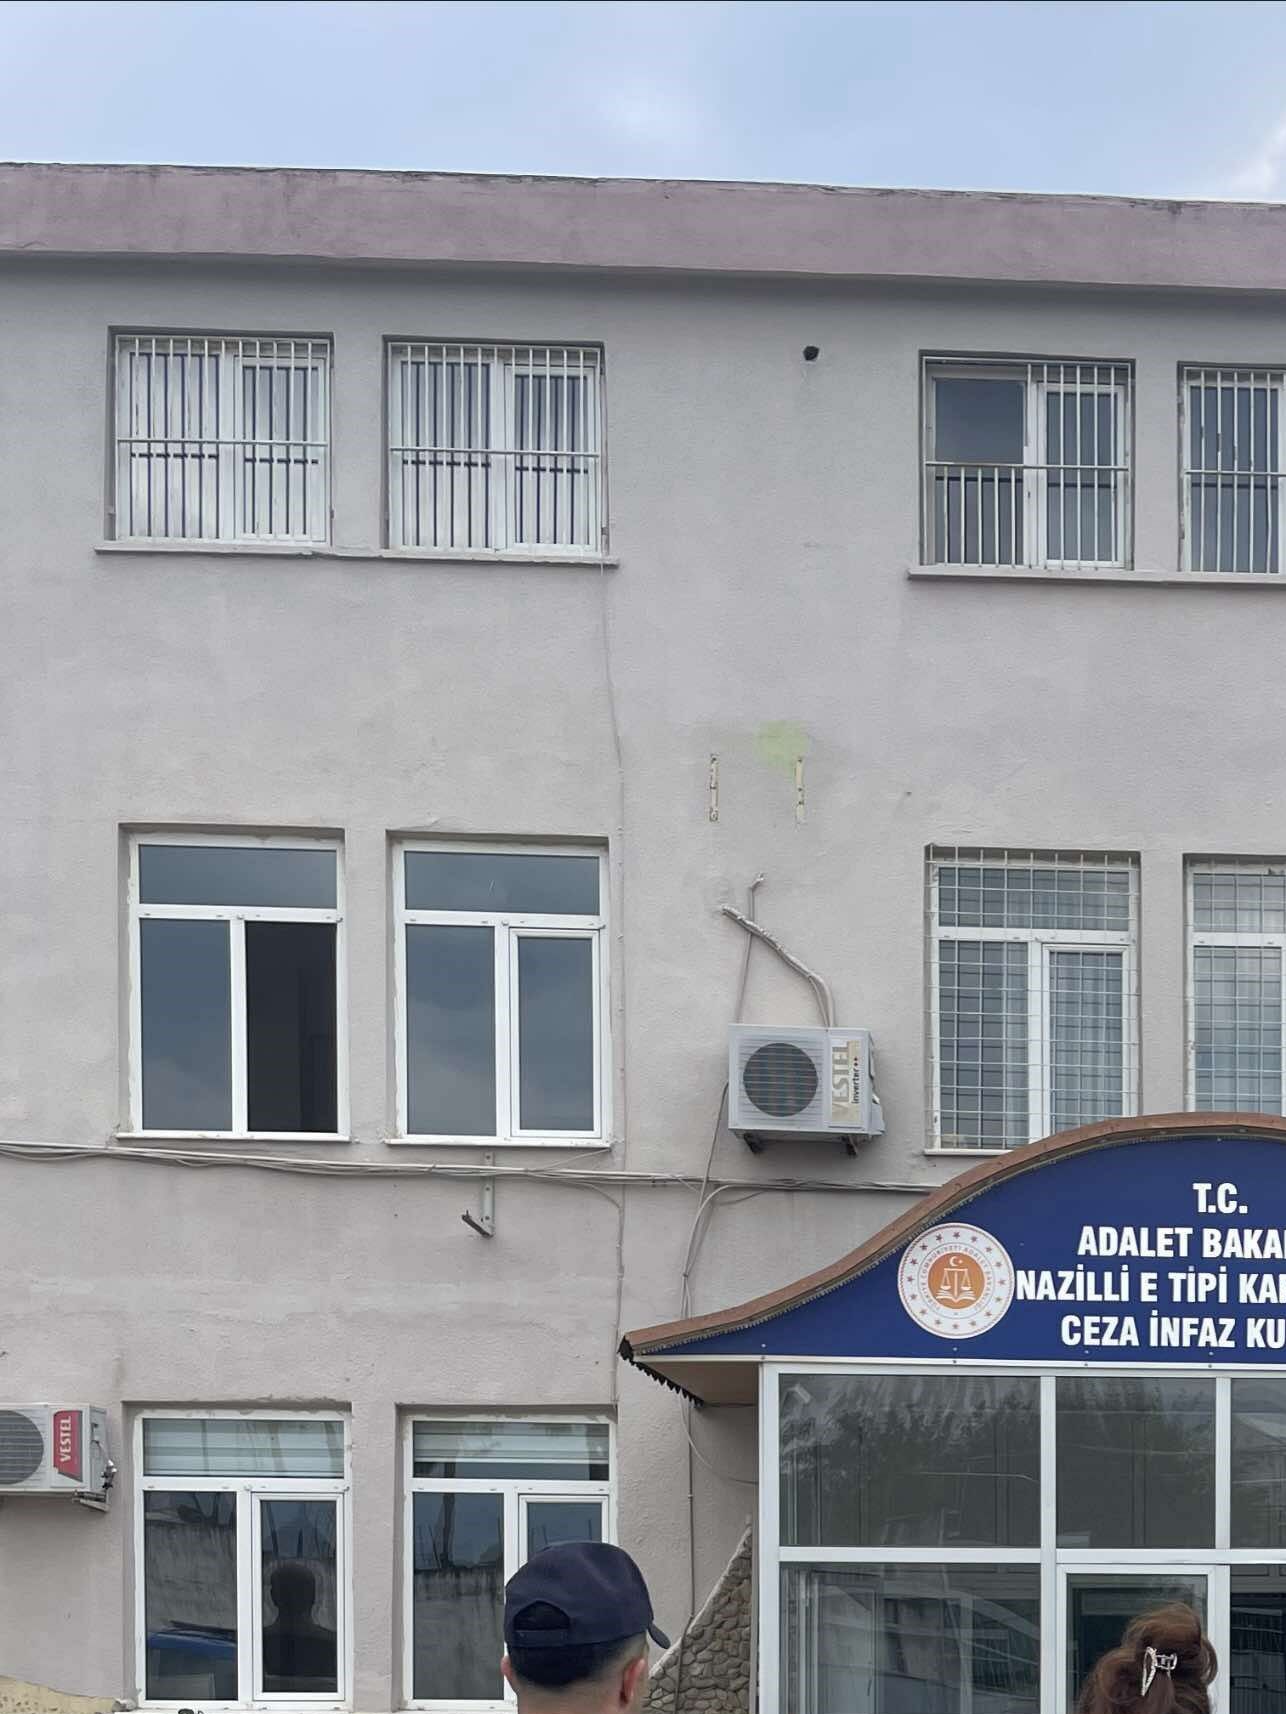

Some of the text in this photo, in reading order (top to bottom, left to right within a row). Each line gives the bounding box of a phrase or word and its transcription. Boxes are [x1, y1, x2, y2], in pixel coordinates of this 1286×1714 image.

[851, 1068, 860, 1104] inverter
[1193, 1183, 1248, 1213] T.C.
[1077, 1226, 1193, 1257] ADALET
[1016, 1264, 1130, 1302] NAZİLLİ
[1141, 1272, 1158, 1302] E
[1168, 1266, 1227, 1303] TİPİ
[1061, 1315, 1140, 1346] CEZA
[1150, 1309, 1236, 1348] İNFAZ
[60, 1416, 72, 1462] VESTEL
